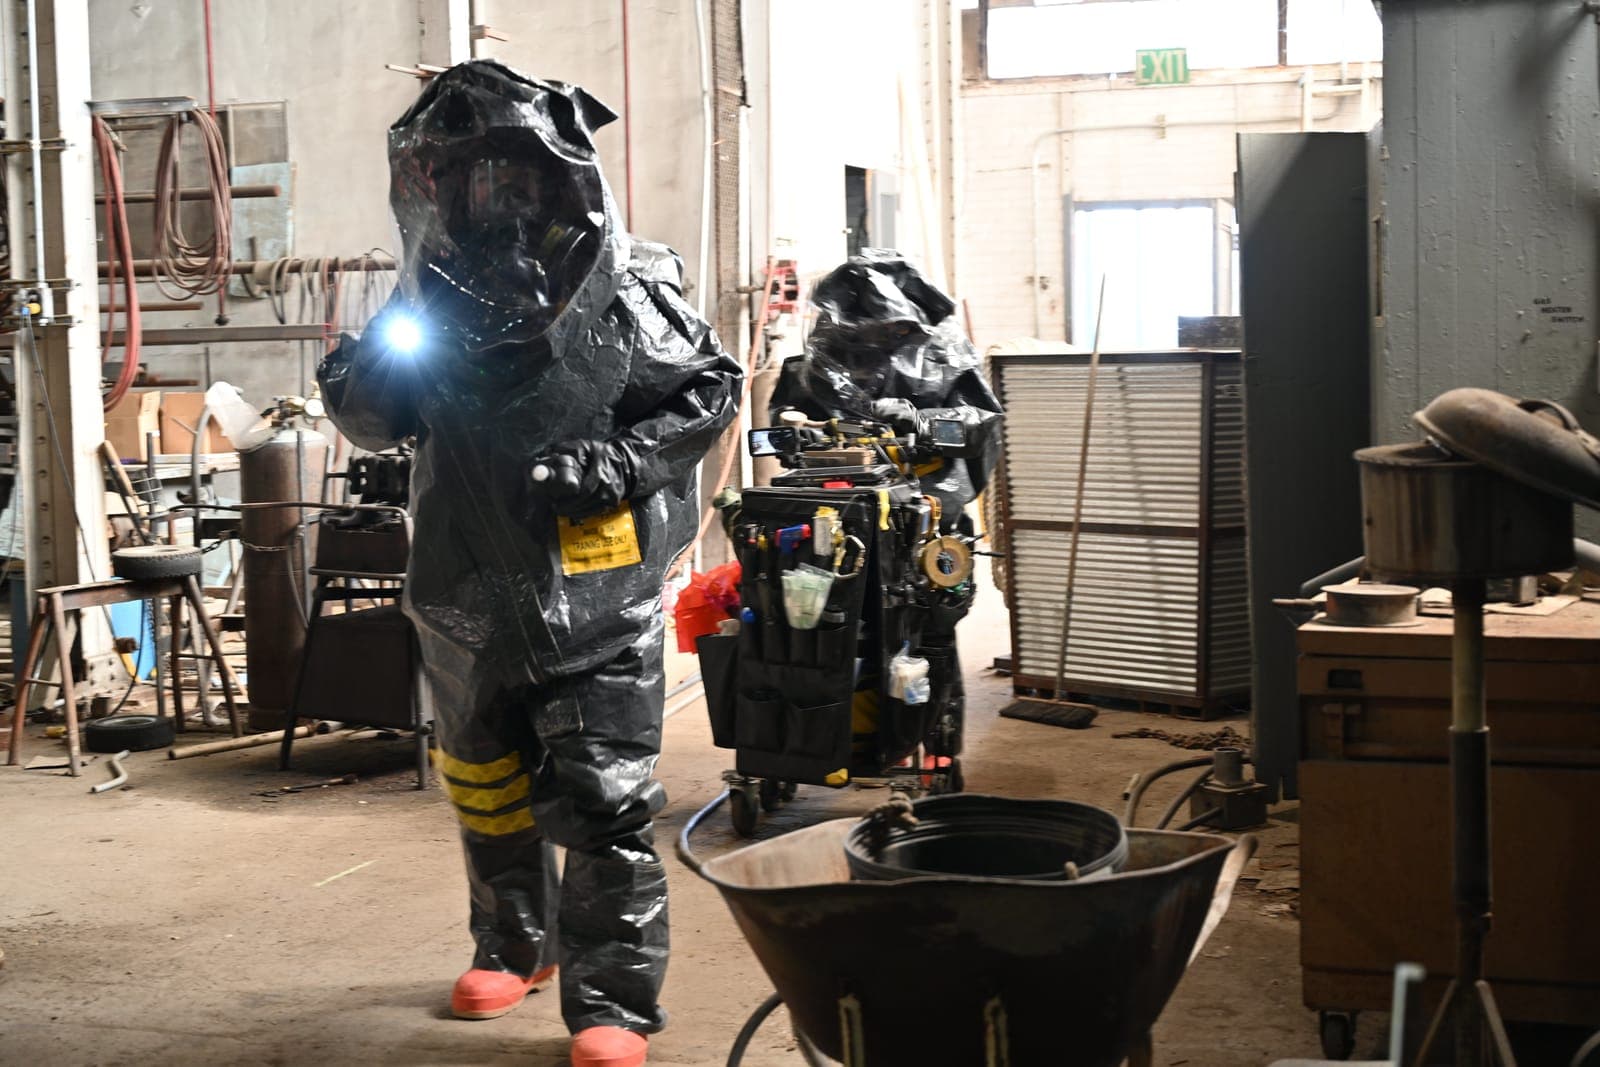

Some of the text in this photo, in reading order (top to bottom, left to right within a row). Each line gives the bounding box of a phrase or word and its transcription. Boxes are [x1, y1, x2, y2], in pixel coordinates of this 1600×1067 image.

[1136, 51, 1185, 83] EXIT
[572, 537, 601, 552] TRAINING
[615, 535, 628, 545] ONLY
